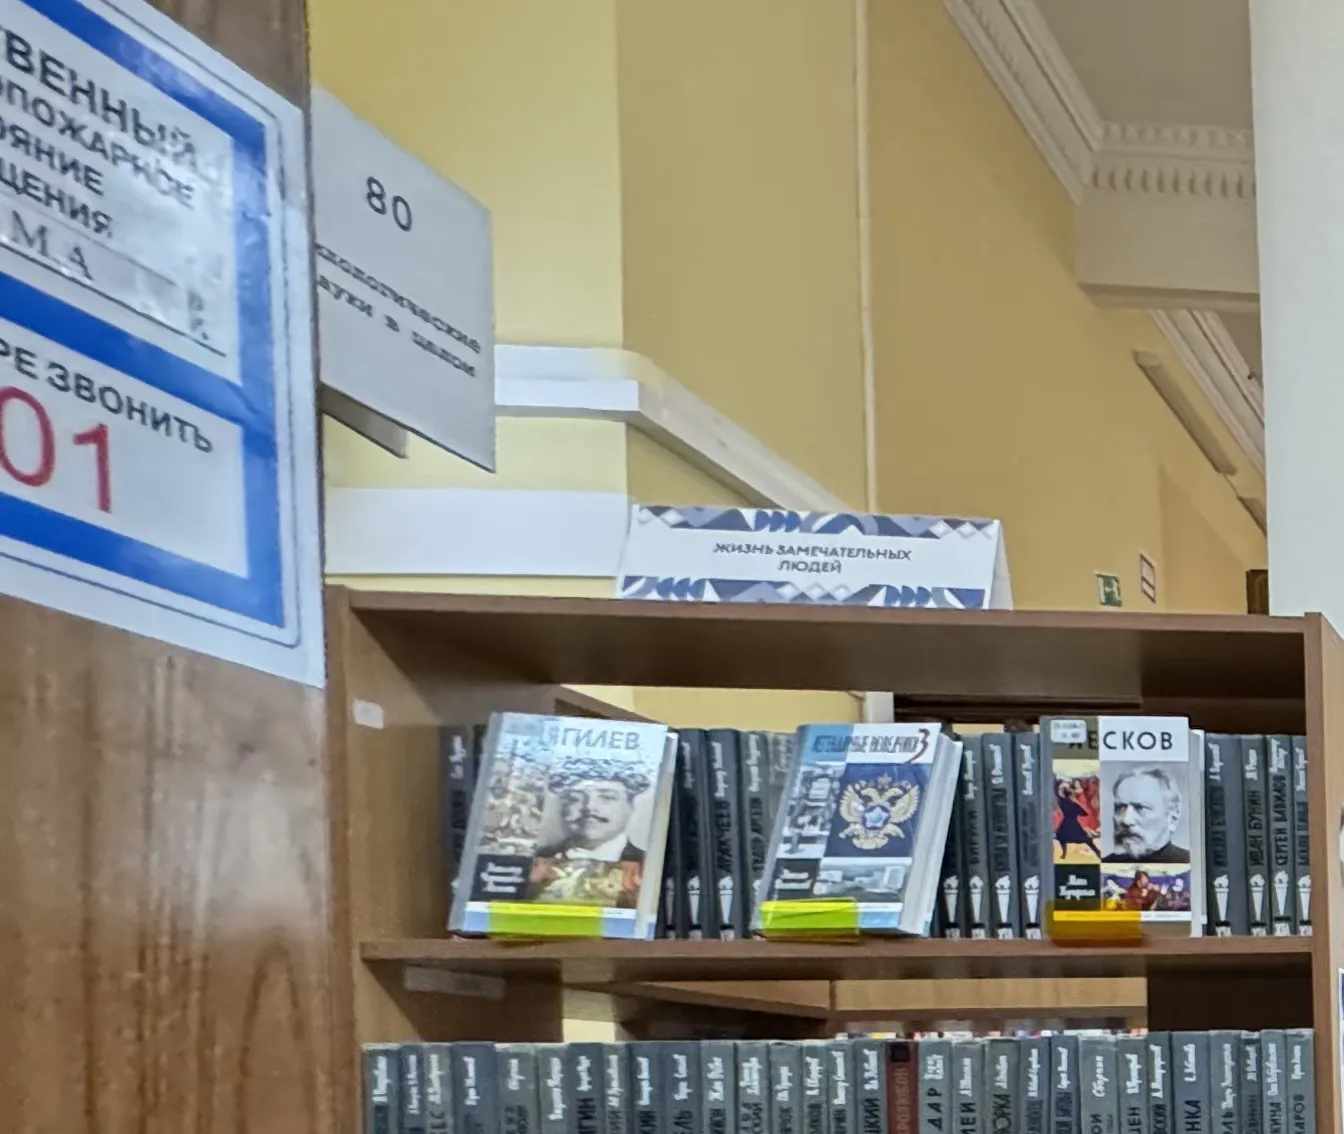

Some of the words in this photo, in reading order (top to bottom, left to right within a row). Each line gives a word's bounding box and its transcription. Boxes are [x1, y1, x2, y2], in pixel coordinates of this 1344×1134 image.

[0, 25, 200, 176] ВЕННЫЙ
[0, 77, 197, 211] ПОЖАРНОЕ
[366, 175, 413, 232] 80
[47, 362, 213, 454] ЗВОНИТЬ
[0, 386, 113, 514] 01
[713, 541, 773, 556] ЖИЗНЬ
[776, 544, 912, 561] ЗАМЕЧАТЕЛЬНЫХ
[777, 559, 842, 574] ЛЮДЕЙ
[1068, 730, 1174, 751] ЕСКОВ
